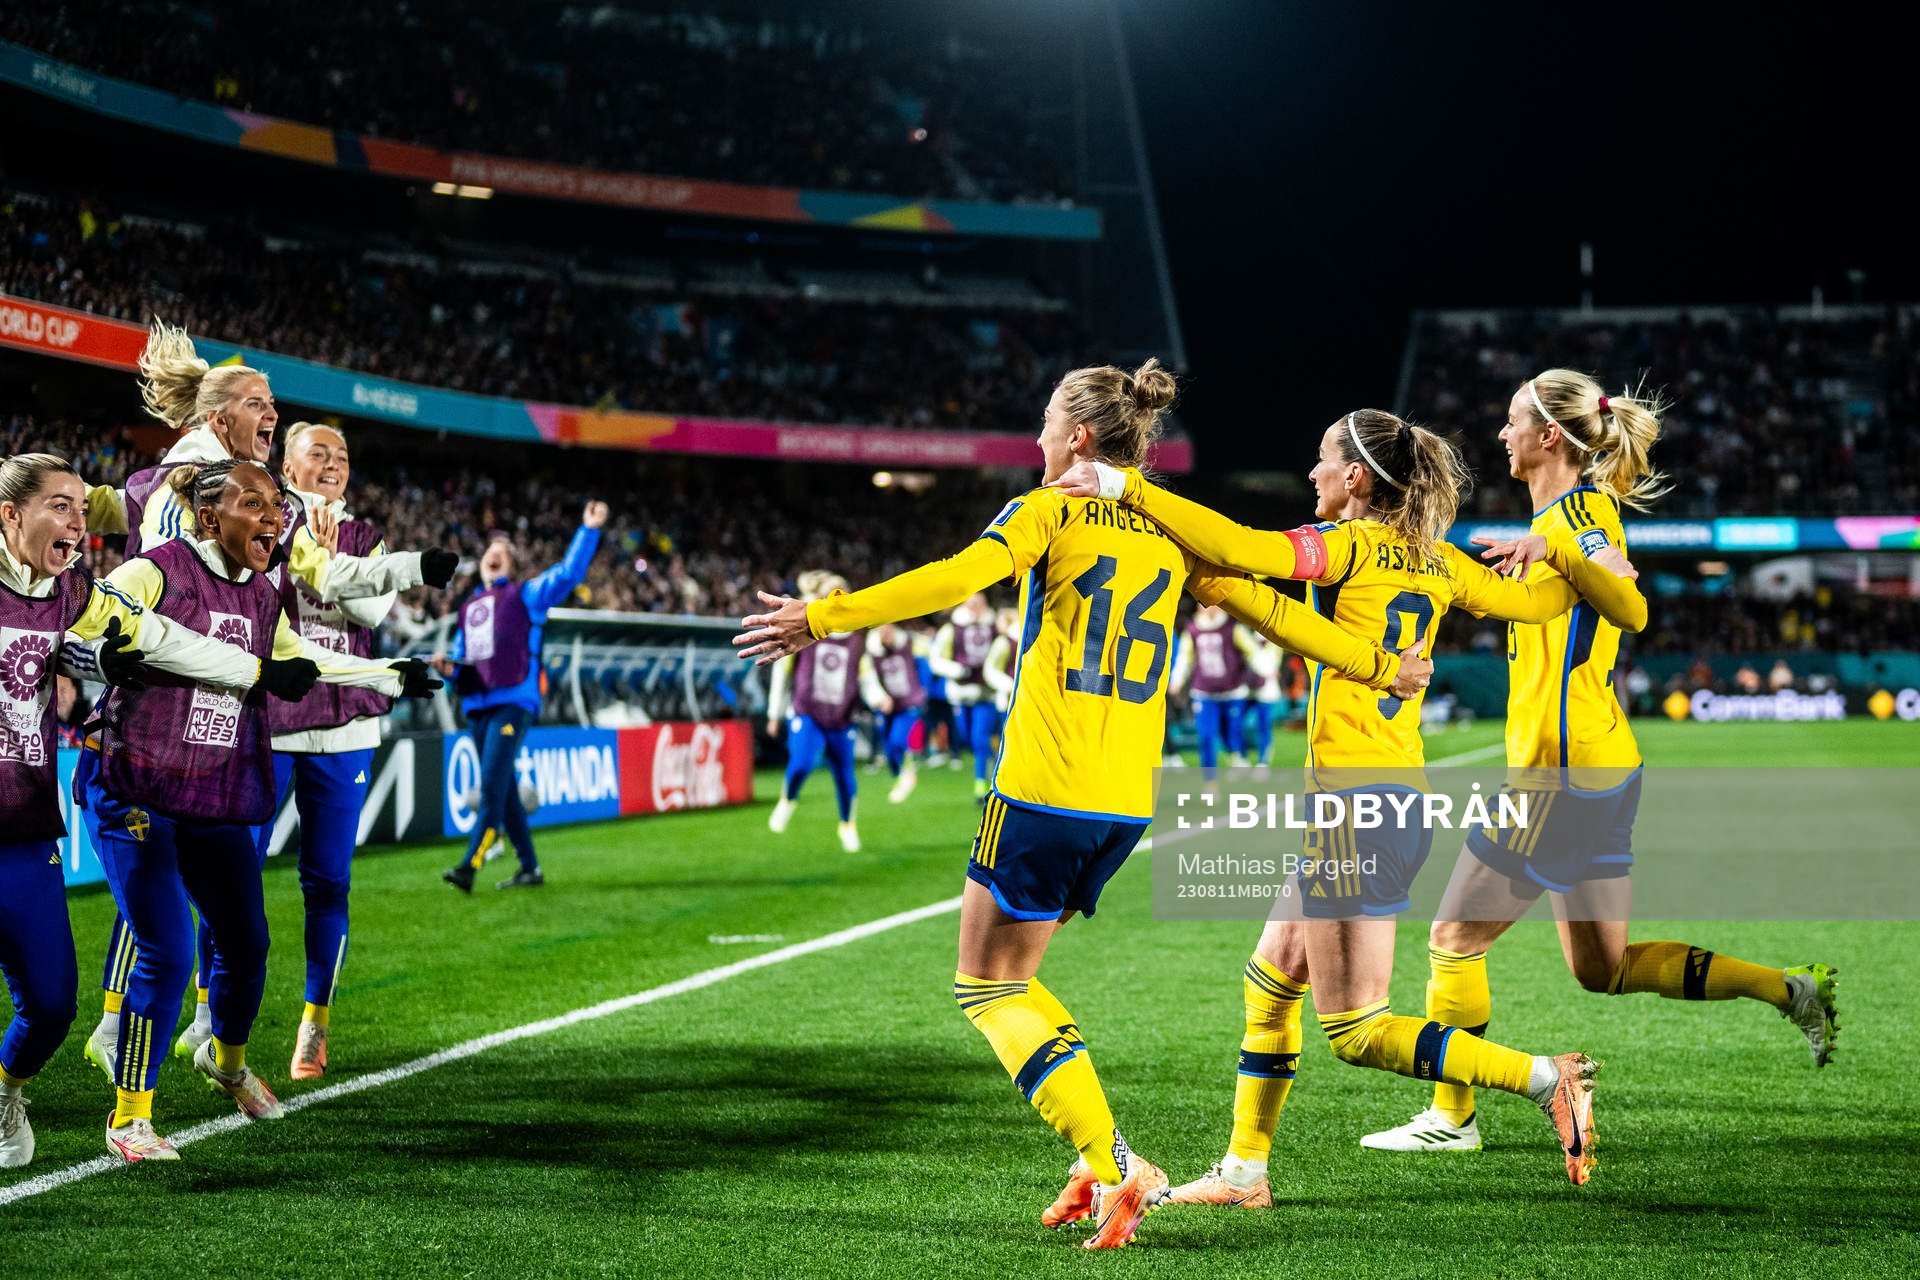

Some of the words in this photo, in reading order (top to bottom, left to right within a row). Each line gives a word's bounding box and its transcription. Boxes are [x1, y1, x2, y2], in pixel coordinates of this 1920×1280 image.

[0, 306, 44, 341] ORLD
[45, 316, 79, 347] CUP
[1065, 555, 1171, 704] 16
[1376, 591, 1434, 720] 9
[188, 724, 208, 740] NZ
[209, 726, 234, 742] 23
[191, 710, 211, 725] AU
[212, 712, 236, 729] 20
[534, 746, 618, 806] WANDA
